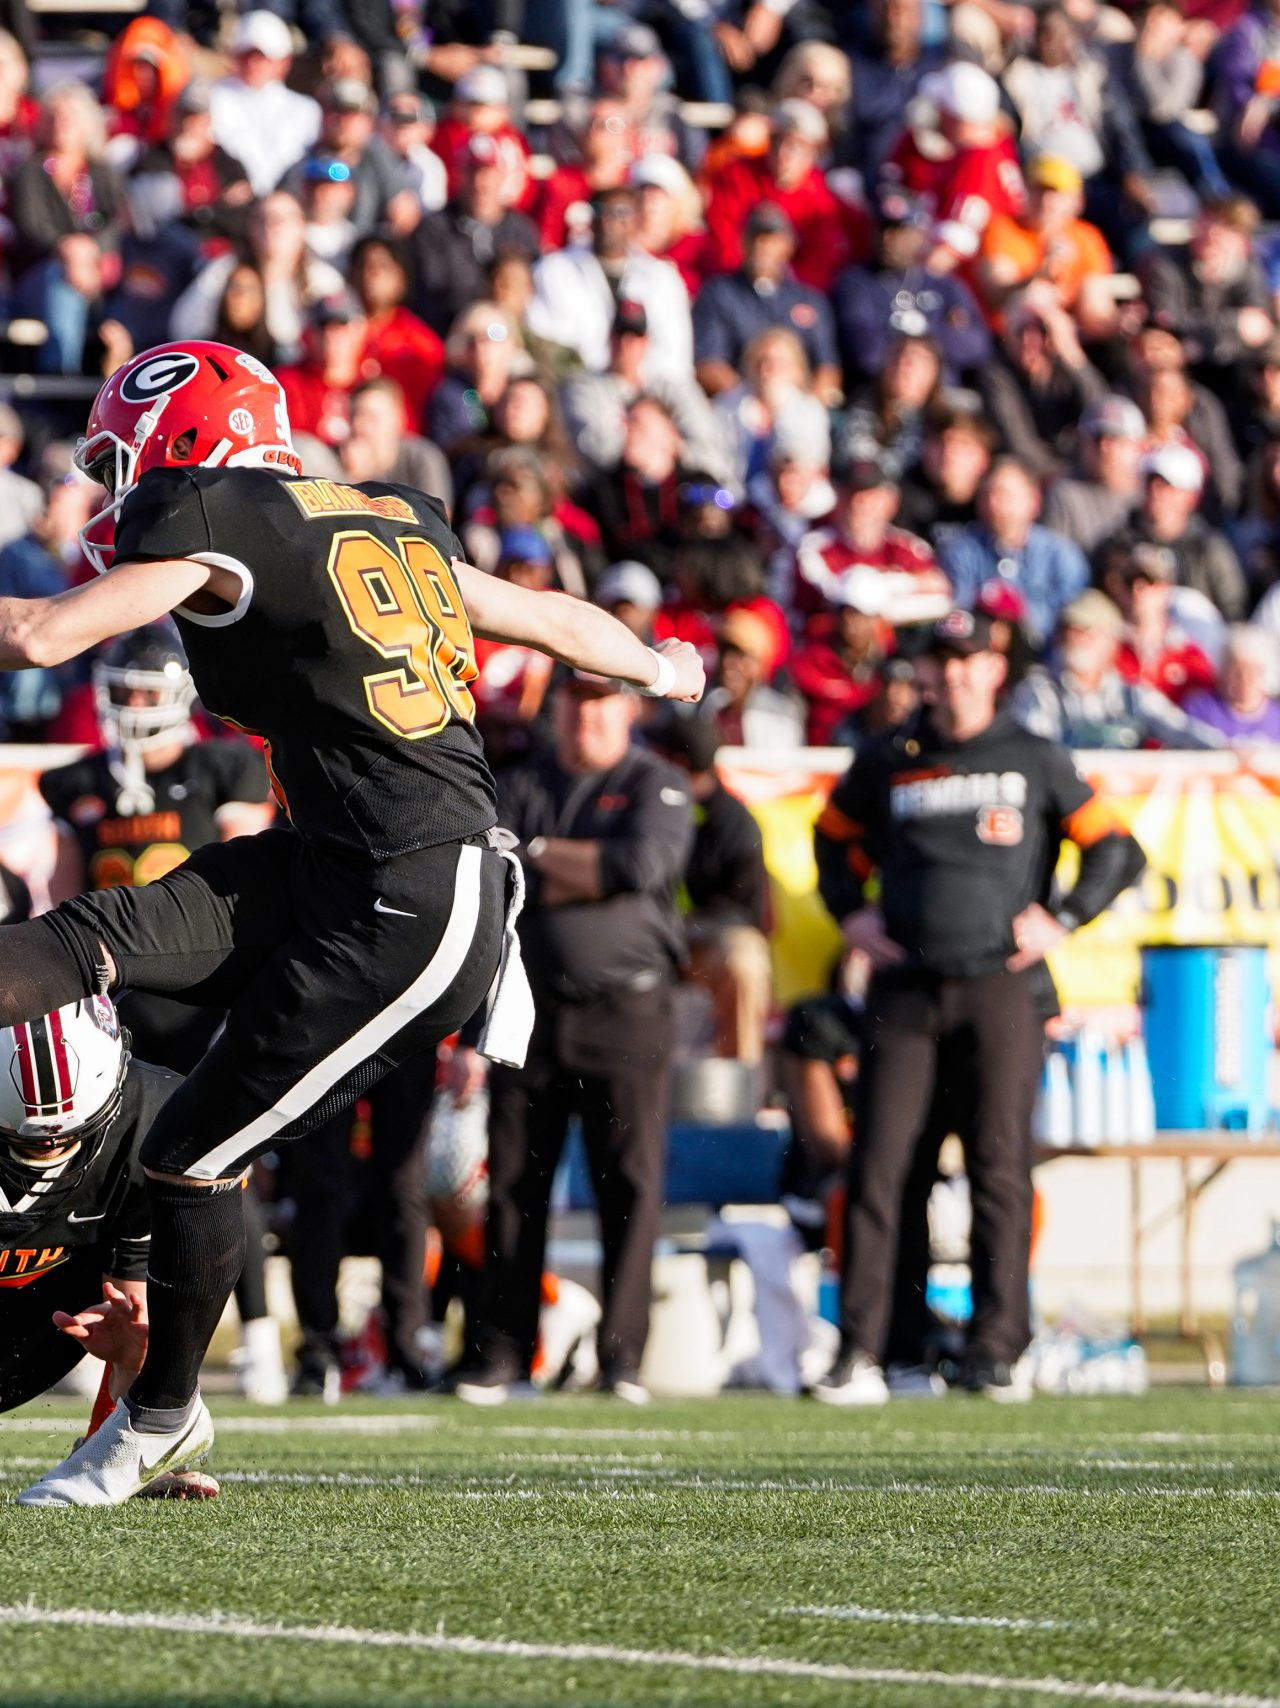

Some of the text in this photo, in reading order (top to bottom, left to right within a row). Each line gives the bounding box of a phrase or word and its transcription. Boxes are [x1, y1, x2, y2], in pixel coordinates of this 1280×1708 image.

[128, 355, 196, 396] G
[231, 412, 251, 432] SEC
[327, 530, 479, 740] 98
